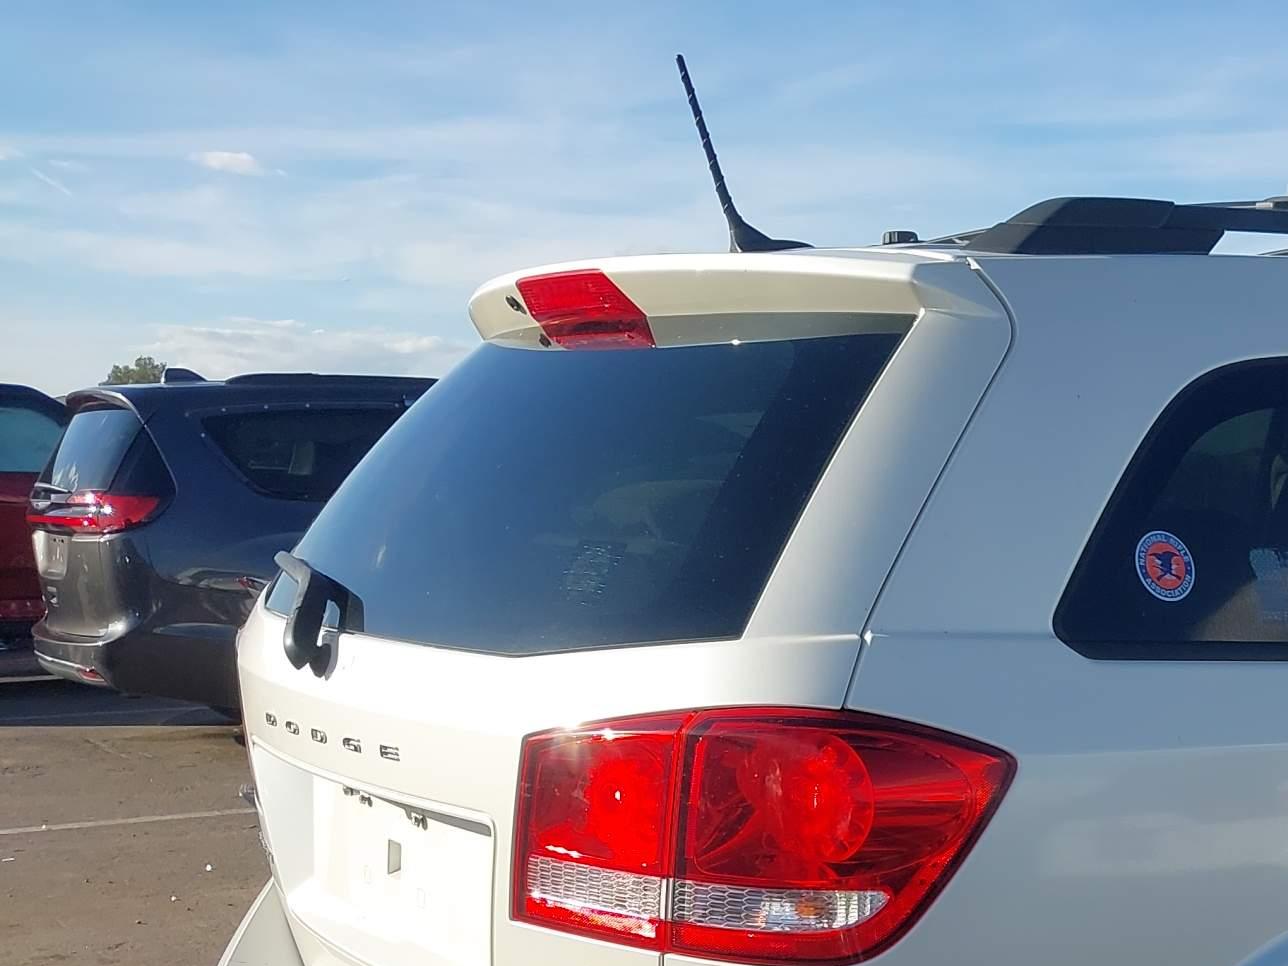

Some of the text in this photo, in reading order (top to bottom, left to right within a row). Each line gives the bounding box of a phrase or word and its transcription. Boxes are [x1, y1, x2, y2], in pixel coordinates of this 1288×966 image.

[1139, 534, 1168, 566] NATIONAL
[1145, 574, 1192, 597] ASSOCIATION
[265, 712, 401, 762] DODGE
